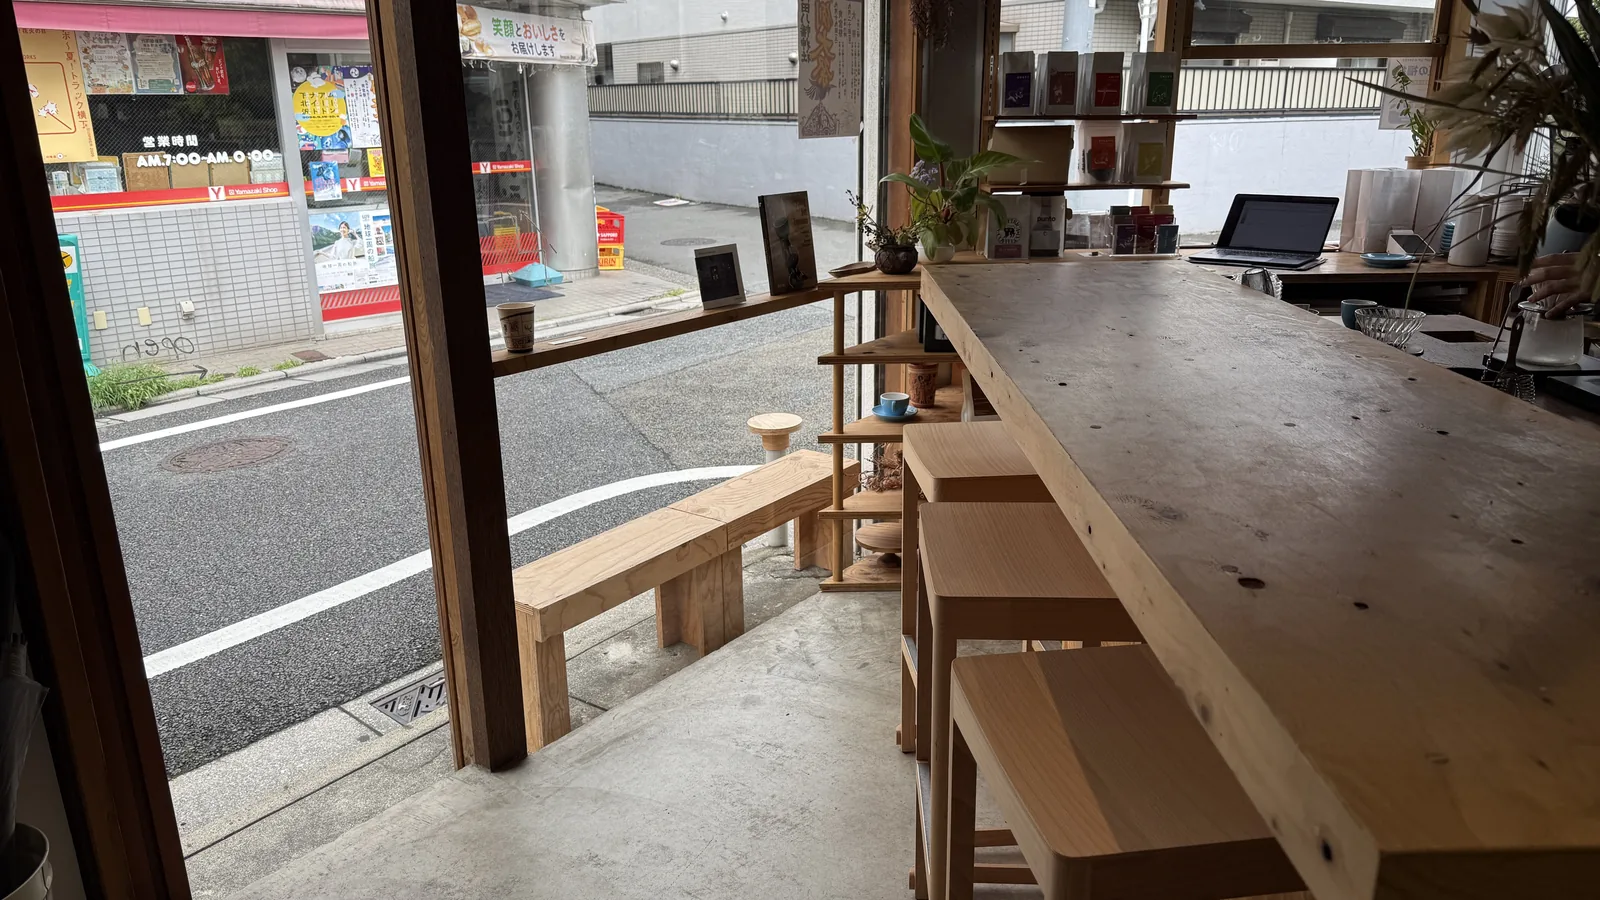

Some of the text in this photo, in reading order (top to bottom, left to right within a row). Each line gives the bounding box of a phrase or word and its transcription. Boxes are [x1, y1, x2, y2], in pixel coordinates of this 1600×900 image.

[491, 17, 566, 41] 笑顔とおいしさを
[510, 41, 556, 57] お届けします
[142, 134, 199, 149] 営業時間
[348, 179, 357, 191] Y
[210, 186, 279, 200] Y Yamazaki Shop
